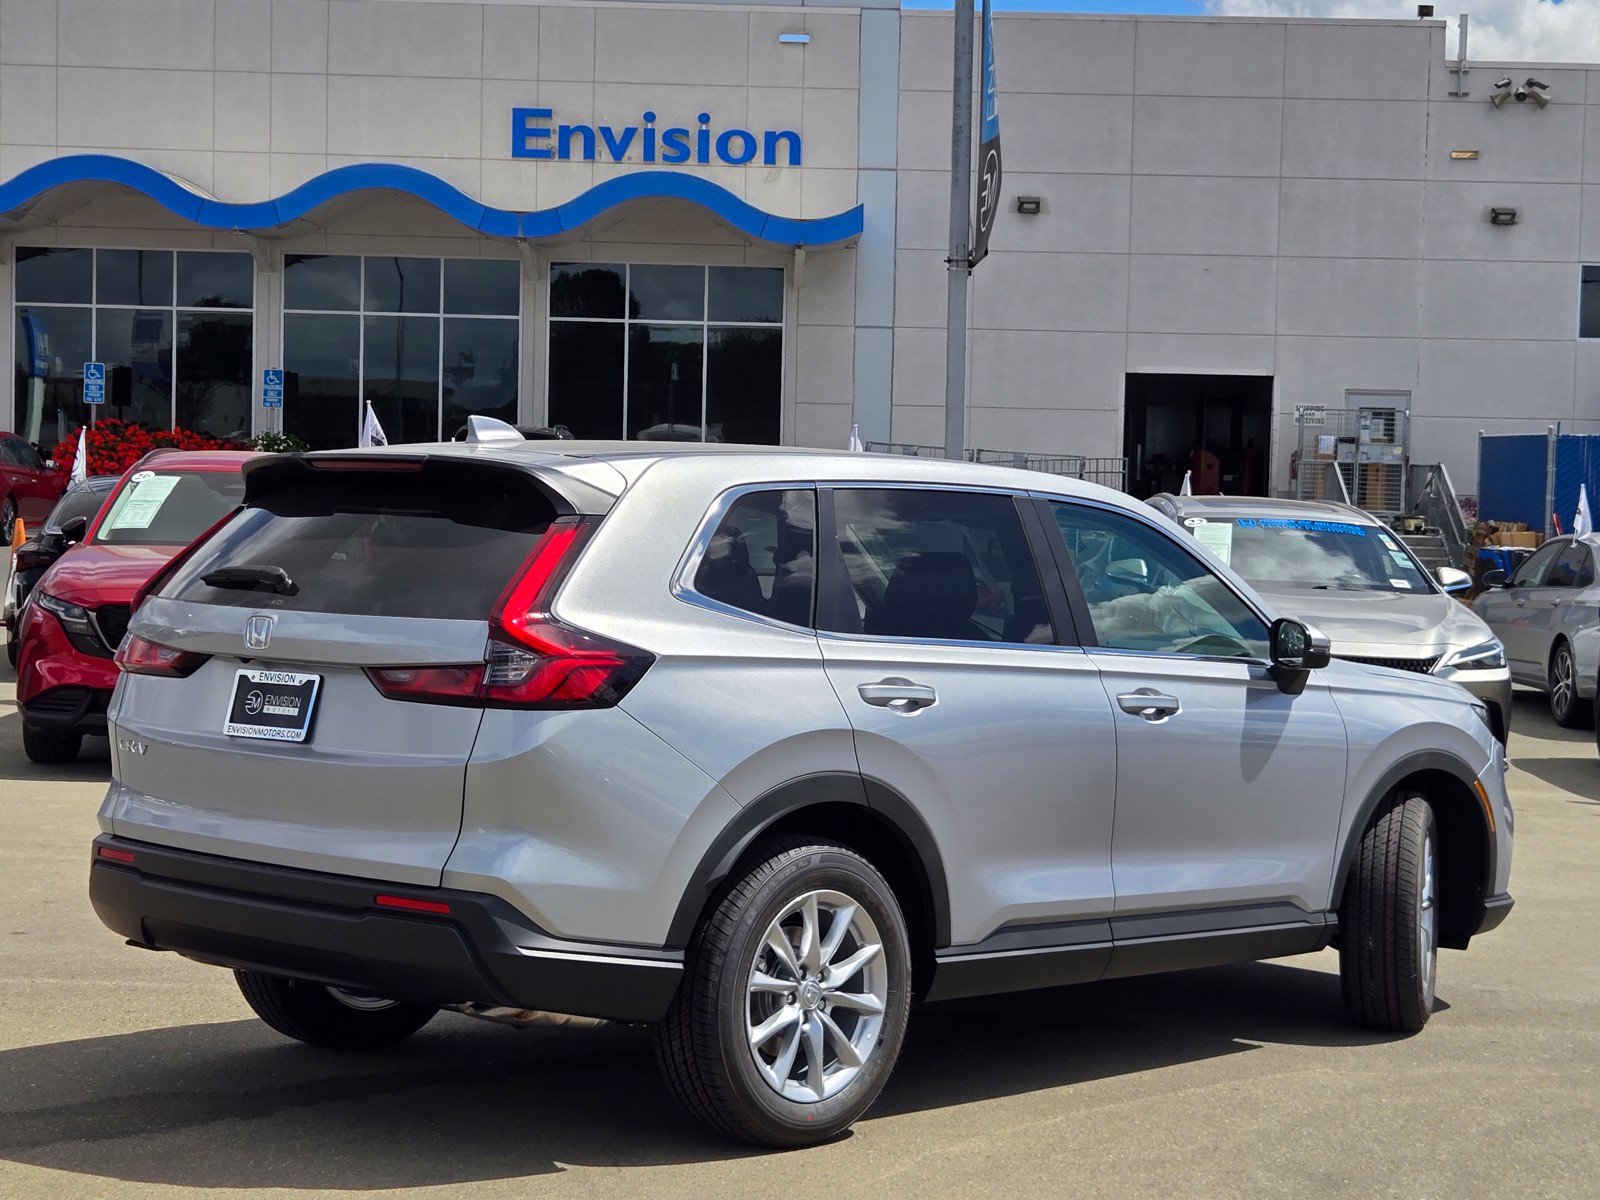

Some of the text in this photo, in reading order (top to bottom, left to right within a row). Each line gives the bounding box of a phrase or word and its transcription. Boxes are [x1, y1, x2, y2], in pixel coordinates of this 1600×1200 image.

[512, 107, 801, 166] Envision
[259, 672, 296, 683] ENVISION
[265, 694, 302, 708] ENVISION
[227, 725, 302, 738] ENVISIONMOTORS.COM
